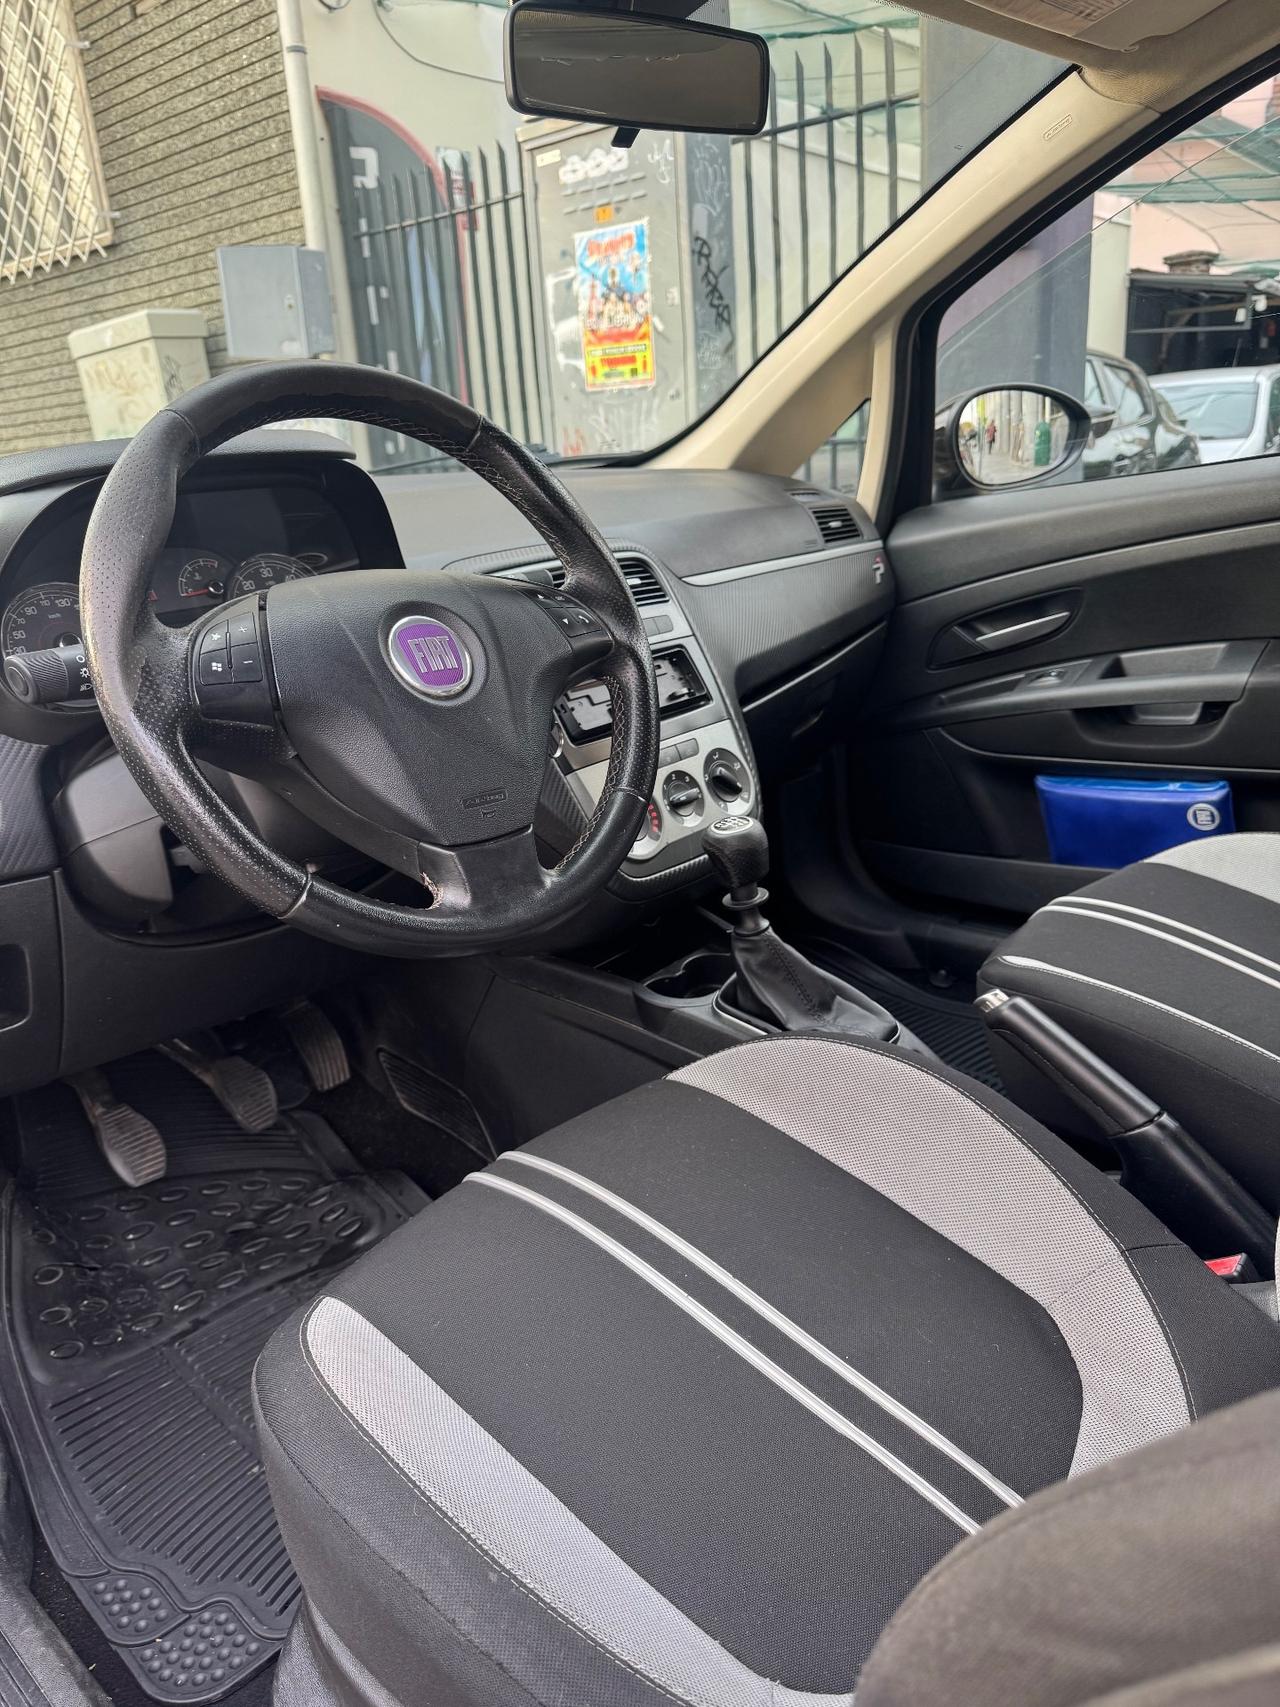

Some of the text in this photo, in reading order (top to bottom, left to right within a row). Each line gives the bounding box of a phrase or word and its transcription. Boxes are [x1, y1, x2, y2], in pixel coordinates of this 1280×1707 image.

[259, 567, 273, 577] 30
[242, 580, 255, 591] 20
[24, 606, 37, 616] 90
[16, 617, 26, 625] 70
[12, 630, 26, 640] 50
[13, 645, 26, 656] 30
[407, 636, 459, 673] FIAT
